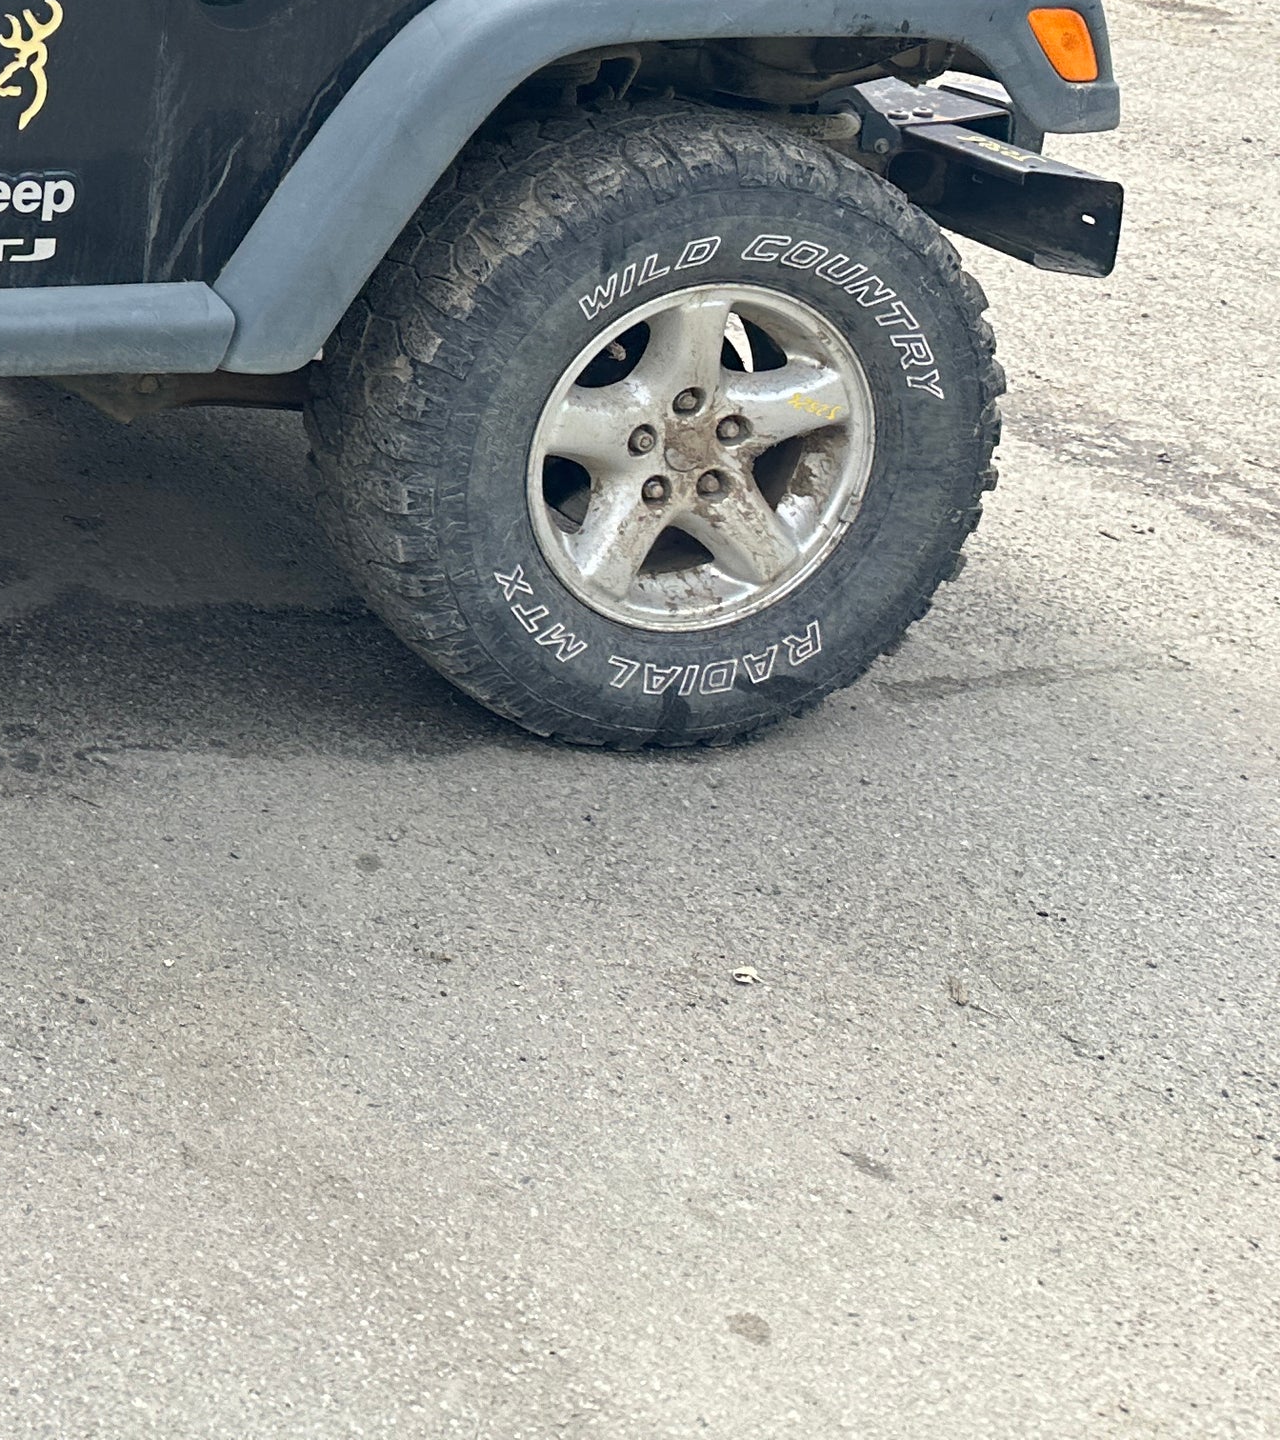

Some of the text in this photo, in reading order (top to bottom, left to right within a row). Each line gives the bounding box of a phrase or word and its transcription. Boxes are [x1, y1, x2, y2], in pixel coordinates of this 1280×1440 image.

[578, 234, 944, 400] WILD COUNTRY
[492, 564, 824, 697] RADIAL MTX
